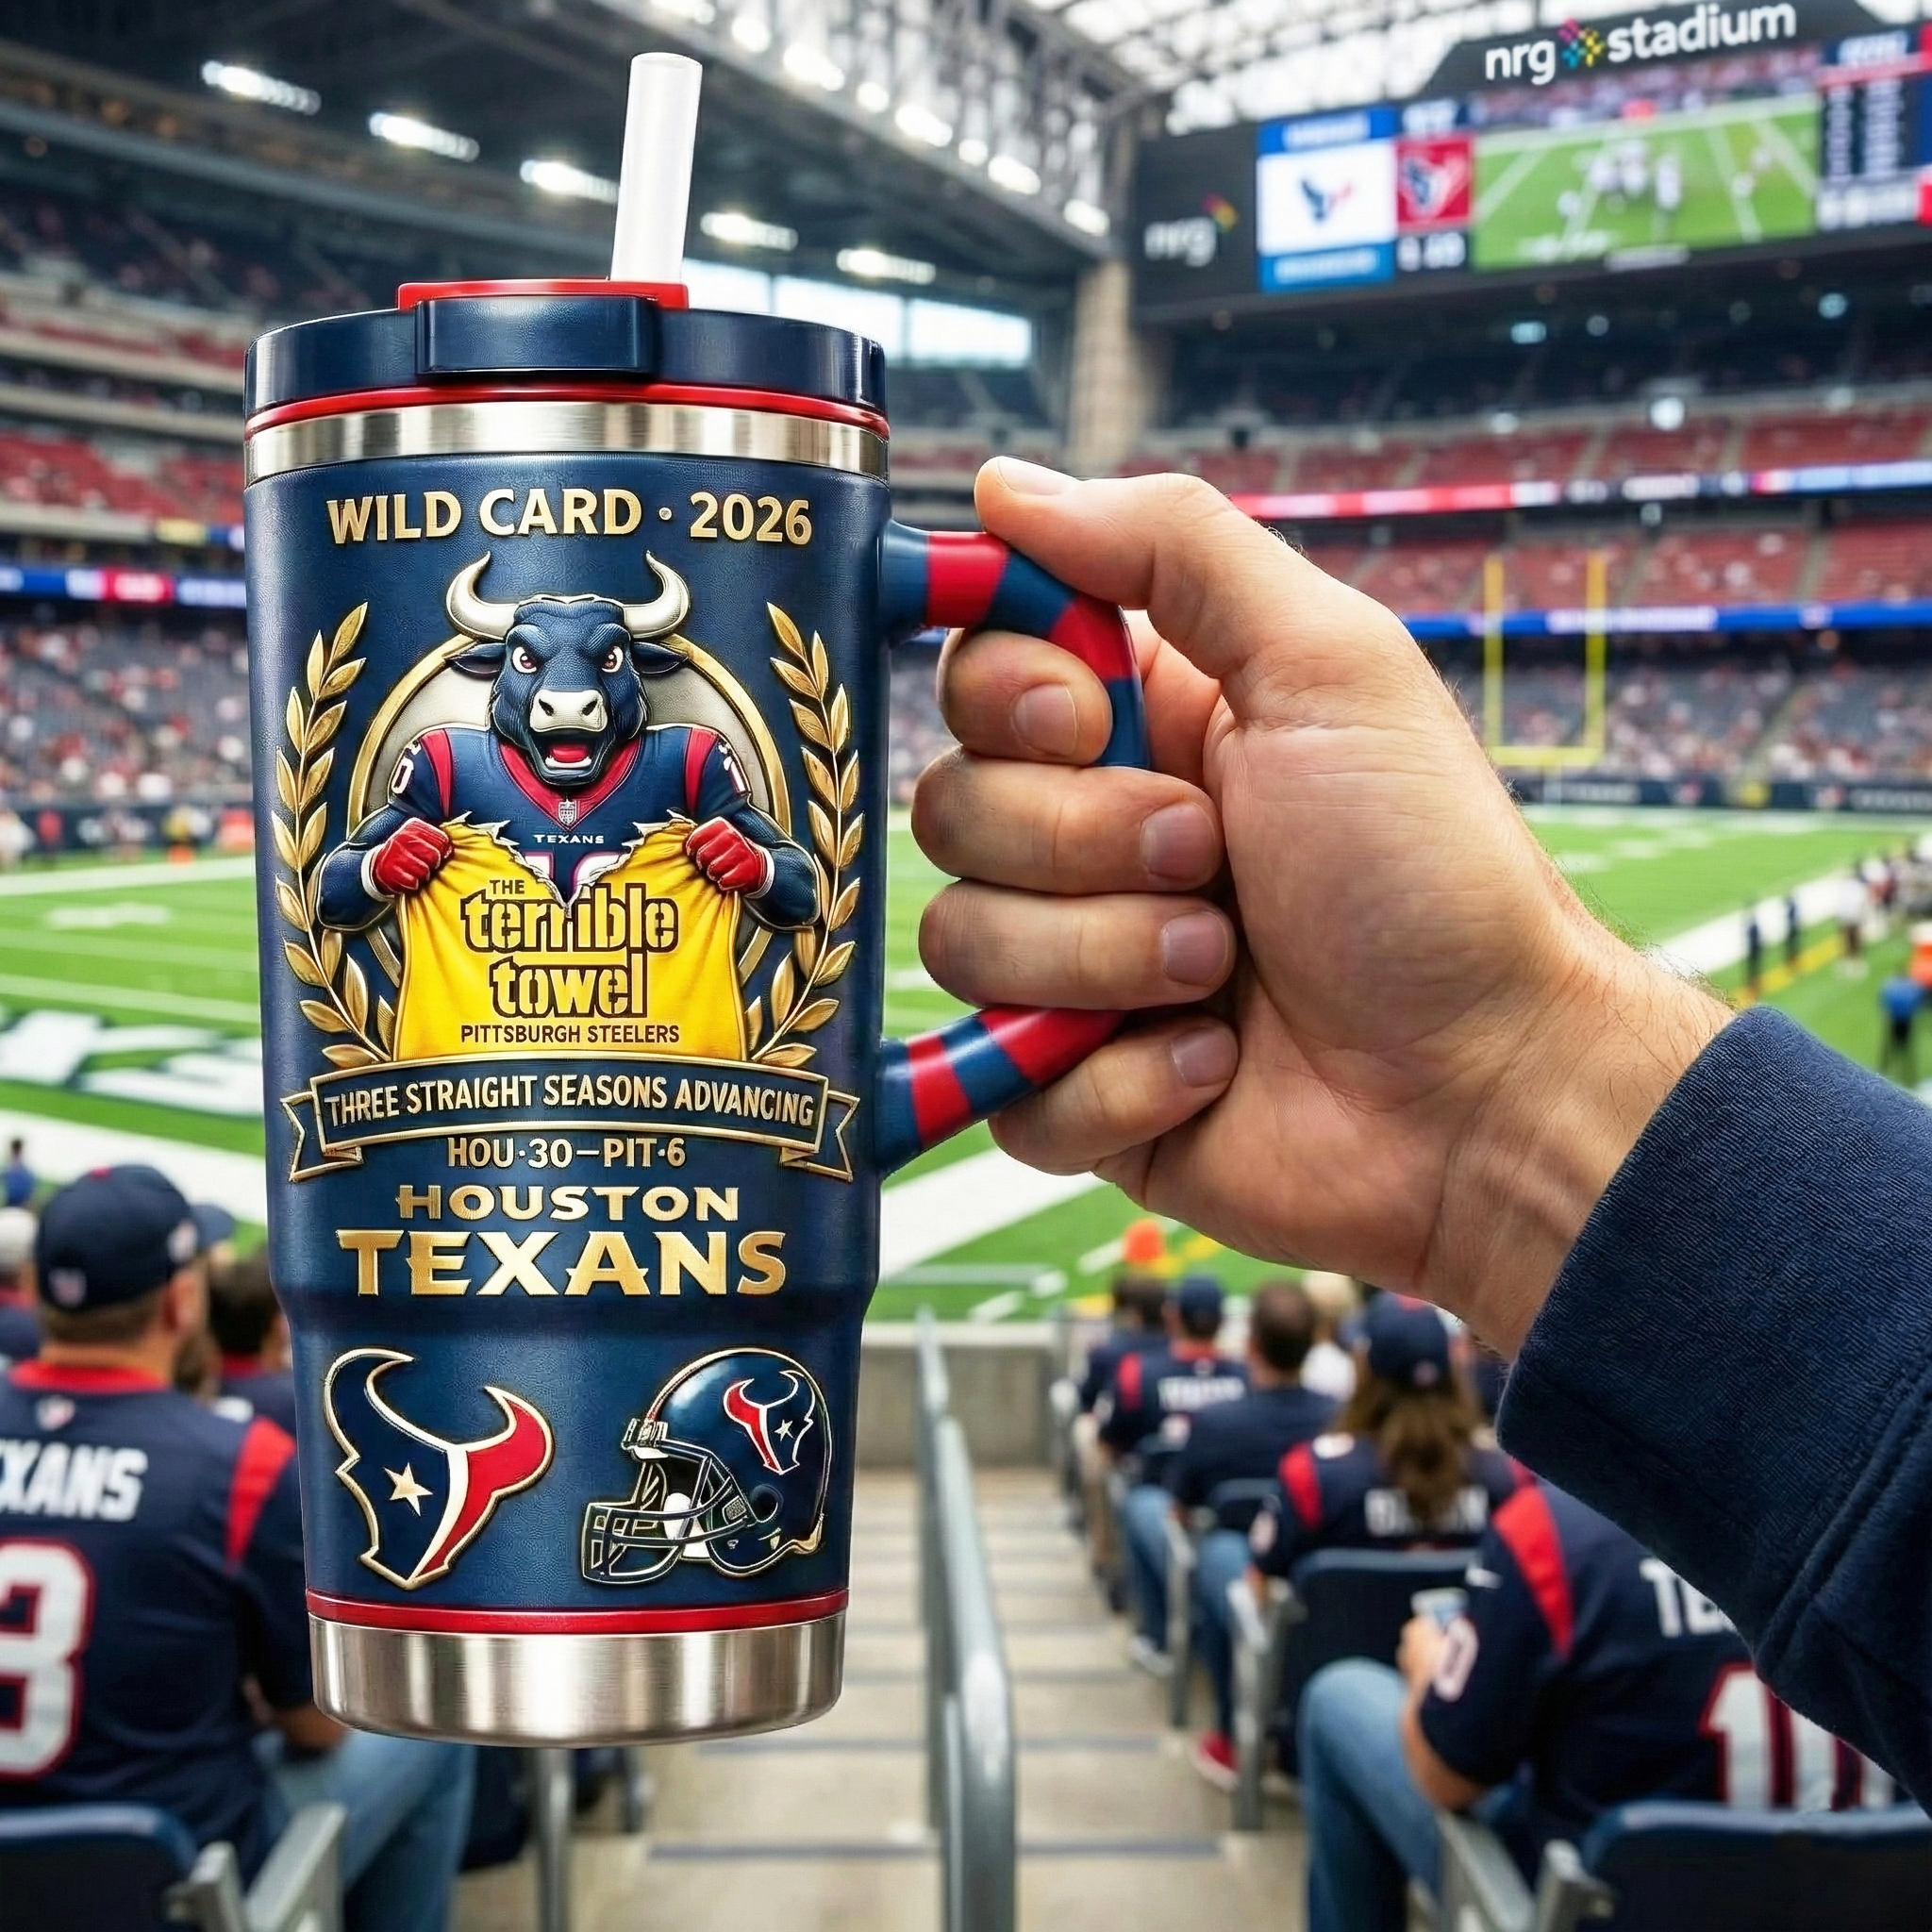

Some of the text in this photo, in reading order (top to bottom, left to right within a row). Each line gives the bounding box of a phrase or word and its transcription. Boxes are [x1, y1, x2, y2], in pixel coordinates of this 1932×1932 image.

[1486, 40, 1556, 86] nrg
[1607, 3, 1796, 63] stadium
[326, 491, 462, 544] WILD
[479, 488, 642, 537] CARD
[689, 491, 813, 545] 2026
[534, 834, 605, 844] TEXANS
[490, 880, 525, 894] THE
[460, 883, 678, 953] terrible
[489, 950, 647, 1018] towel
[461, 1024, 679, 1042] PITTSBURGH STEELERS
[325, 1074, 814, 1127] THREE STRAIGHT SEASONS ADVANCING
[396, 1185, 739, 1221] HOUSTON
[335, 1229, 787, 1296] TEXANS
[0, 1439, 148, 1522] XANS
